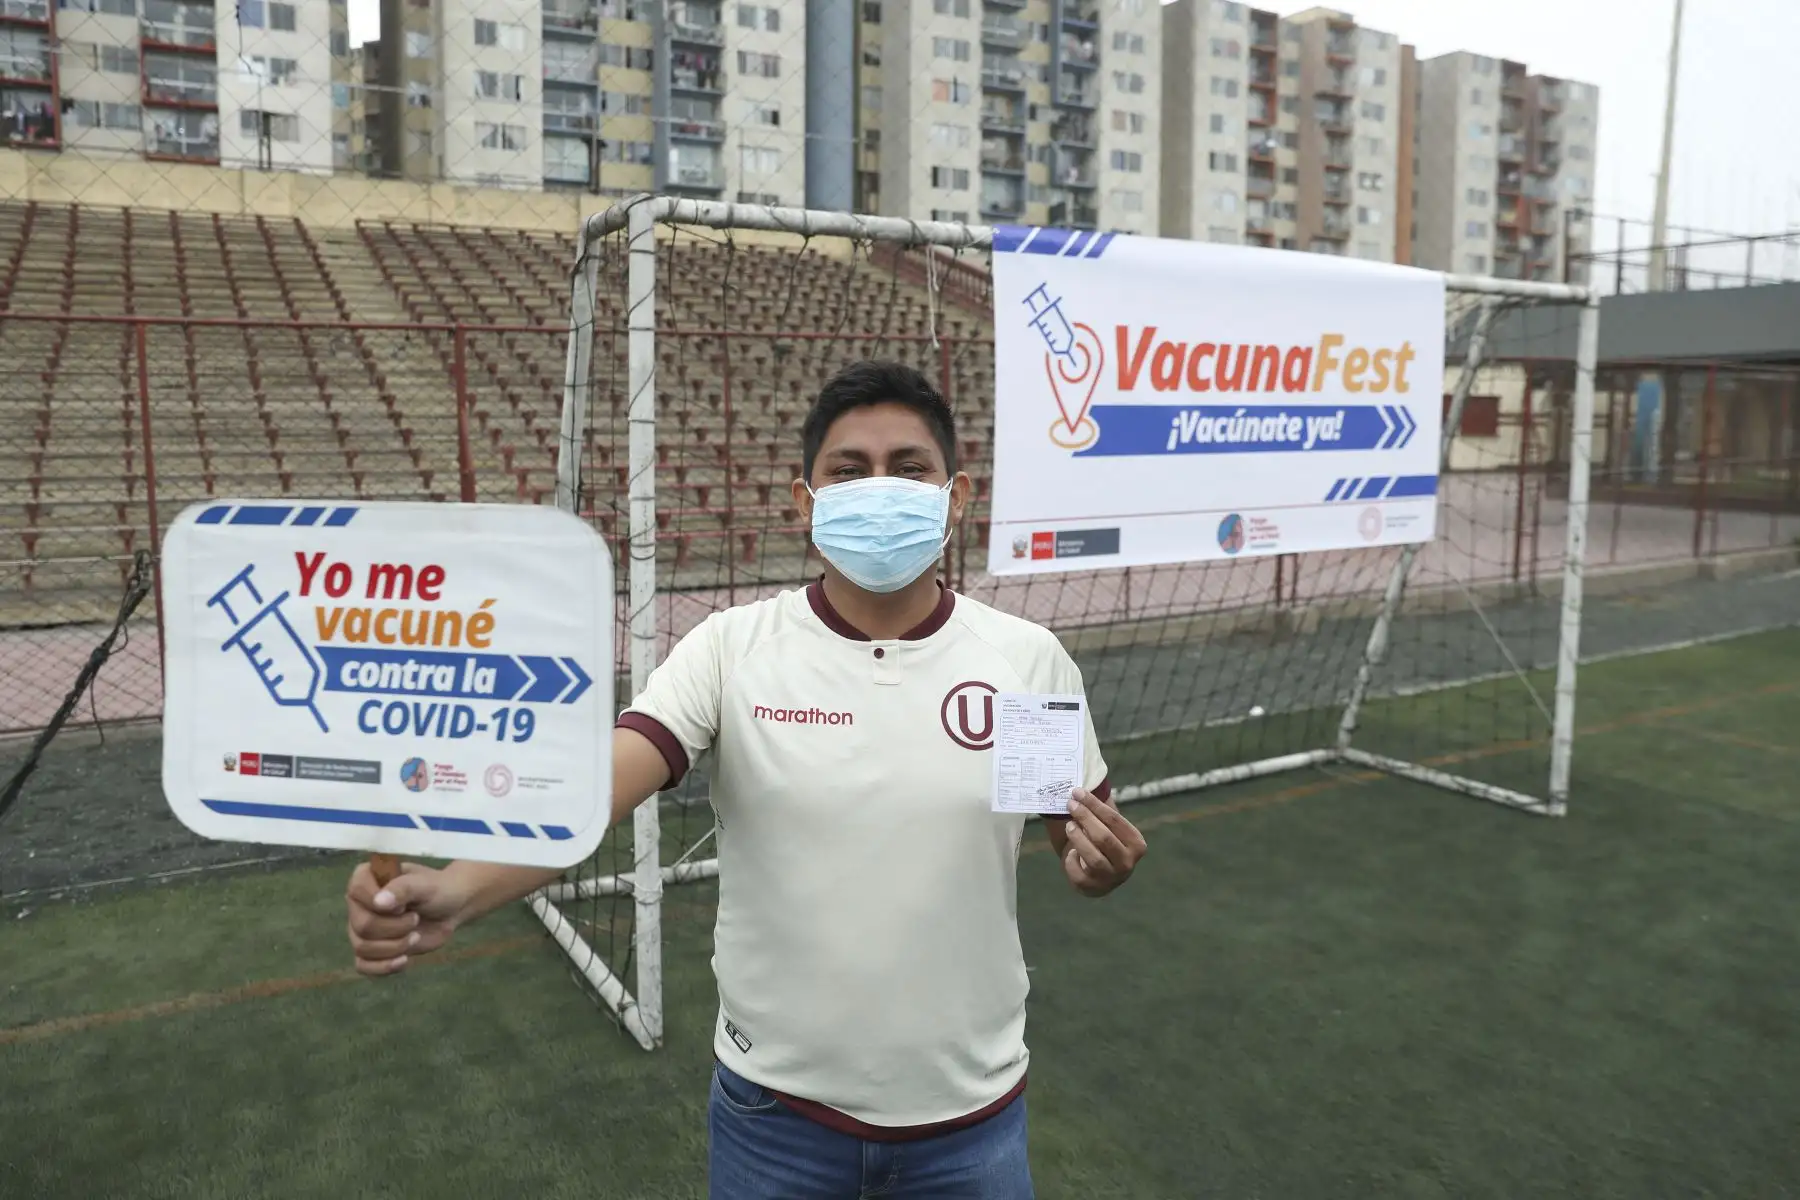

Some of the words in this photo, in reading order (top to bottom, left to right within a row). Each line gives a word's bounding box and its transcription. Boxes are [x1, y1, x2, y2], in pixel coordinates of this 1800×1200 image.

[1115, 325, 1415, 393] VacunaFest
[1166, 409, 1302, 451] ¡Vacúnate
[1303, 411, 1345, 450] ya!
[295, 551, 353, 598] Yo
[367, 563, 445, 601] me
[315, 598, 499, 649] vacuné
[340, 659, 456, 692] contra
[462, 657, 497, 694] la
[357, 698, 536, 744] COVID-19
[754, 705, 853, 726] marathon
[957, 694, 994, 742] U
